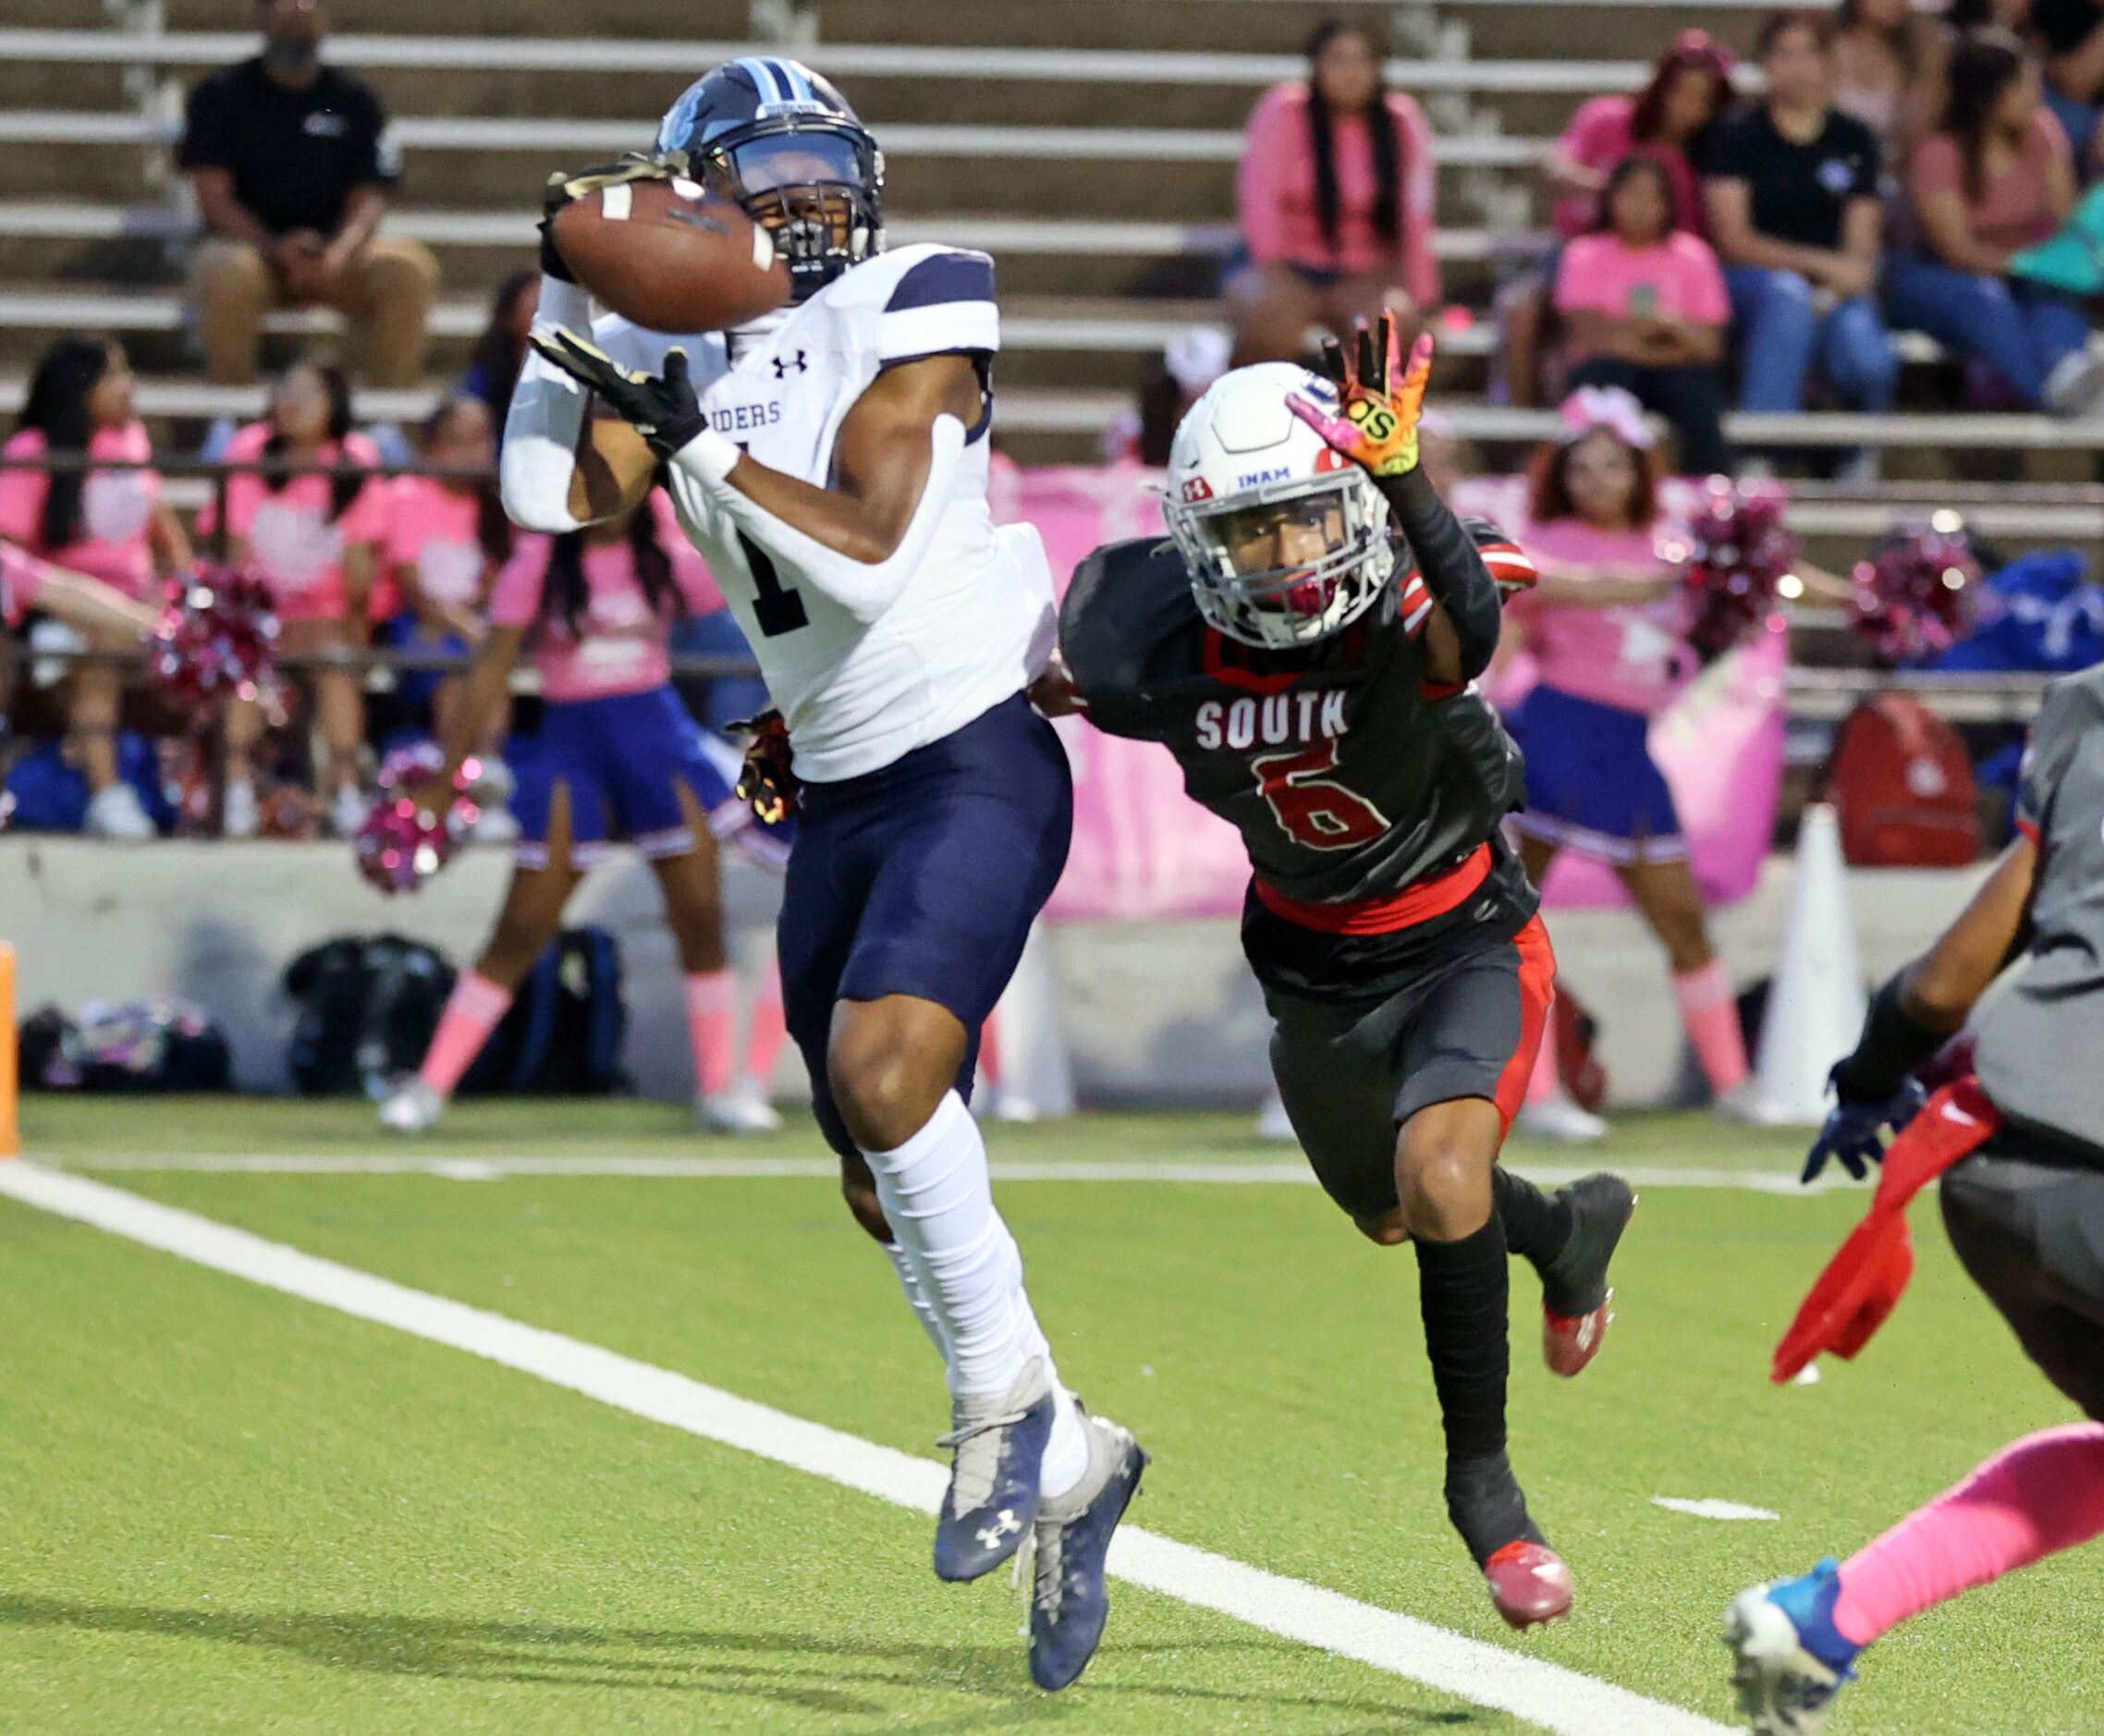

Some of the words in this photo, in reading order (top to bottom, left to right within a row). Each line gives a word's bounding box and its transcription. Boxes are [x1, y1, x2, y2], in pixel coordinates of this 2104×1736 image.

[712, 401, 780, 433] IDERS
[736, 442, 810, 638] 1
[1196, 691, 1349, 750] SOUTH
[1250, 737, 1391, 851] 6
